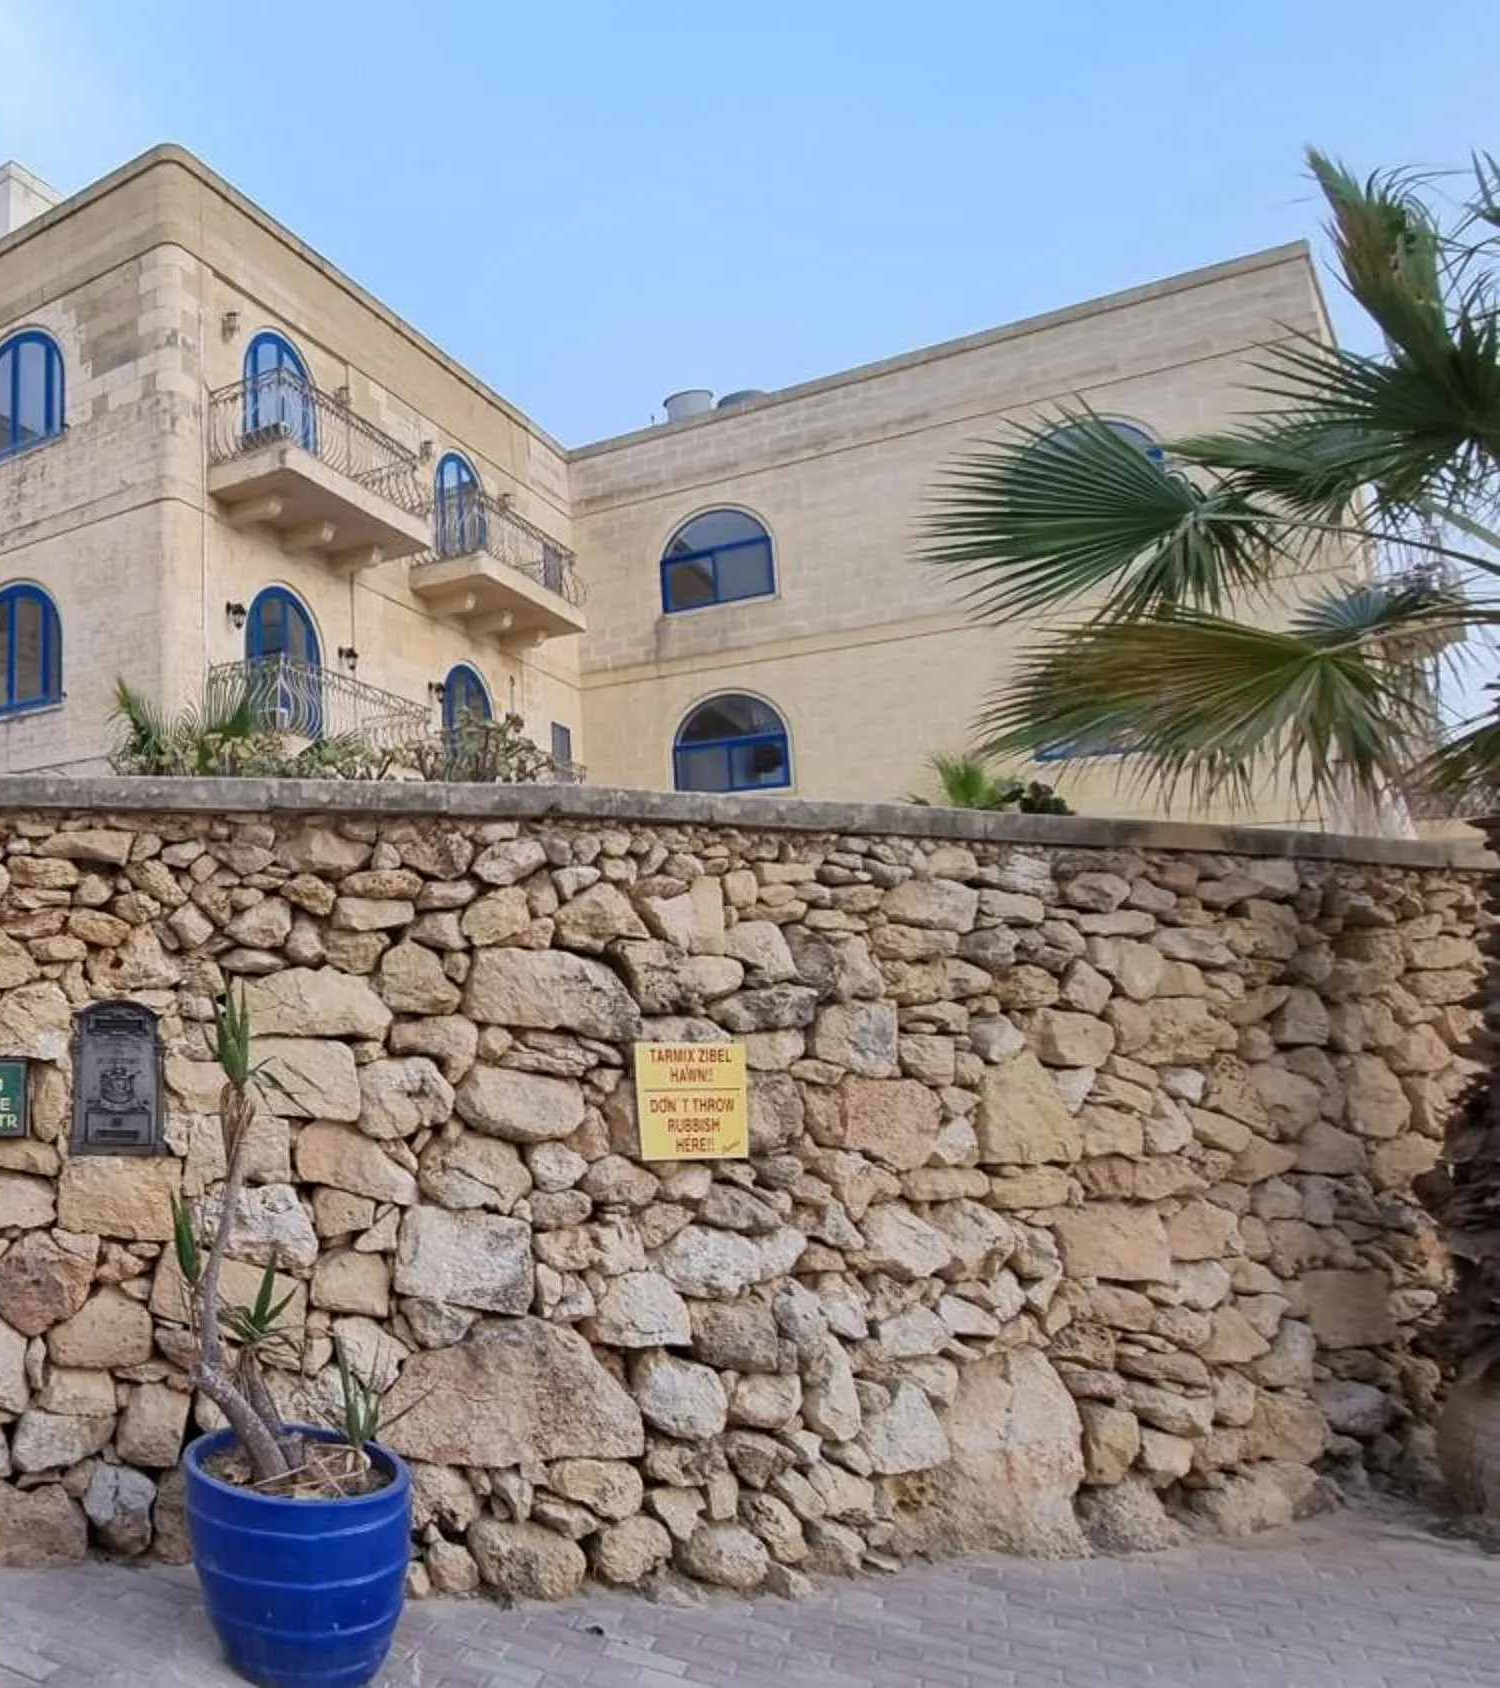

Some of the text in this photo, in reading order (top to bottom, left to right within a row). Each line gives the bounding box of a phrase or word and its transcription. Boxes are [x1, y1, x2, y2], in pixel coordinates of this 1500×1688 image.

[649, 1047, 732, 1063] TARMIX ZIBEL
[692, 1097, 735, 1113] THROW
[667, 1117, 721, 1133] RUBBISH
